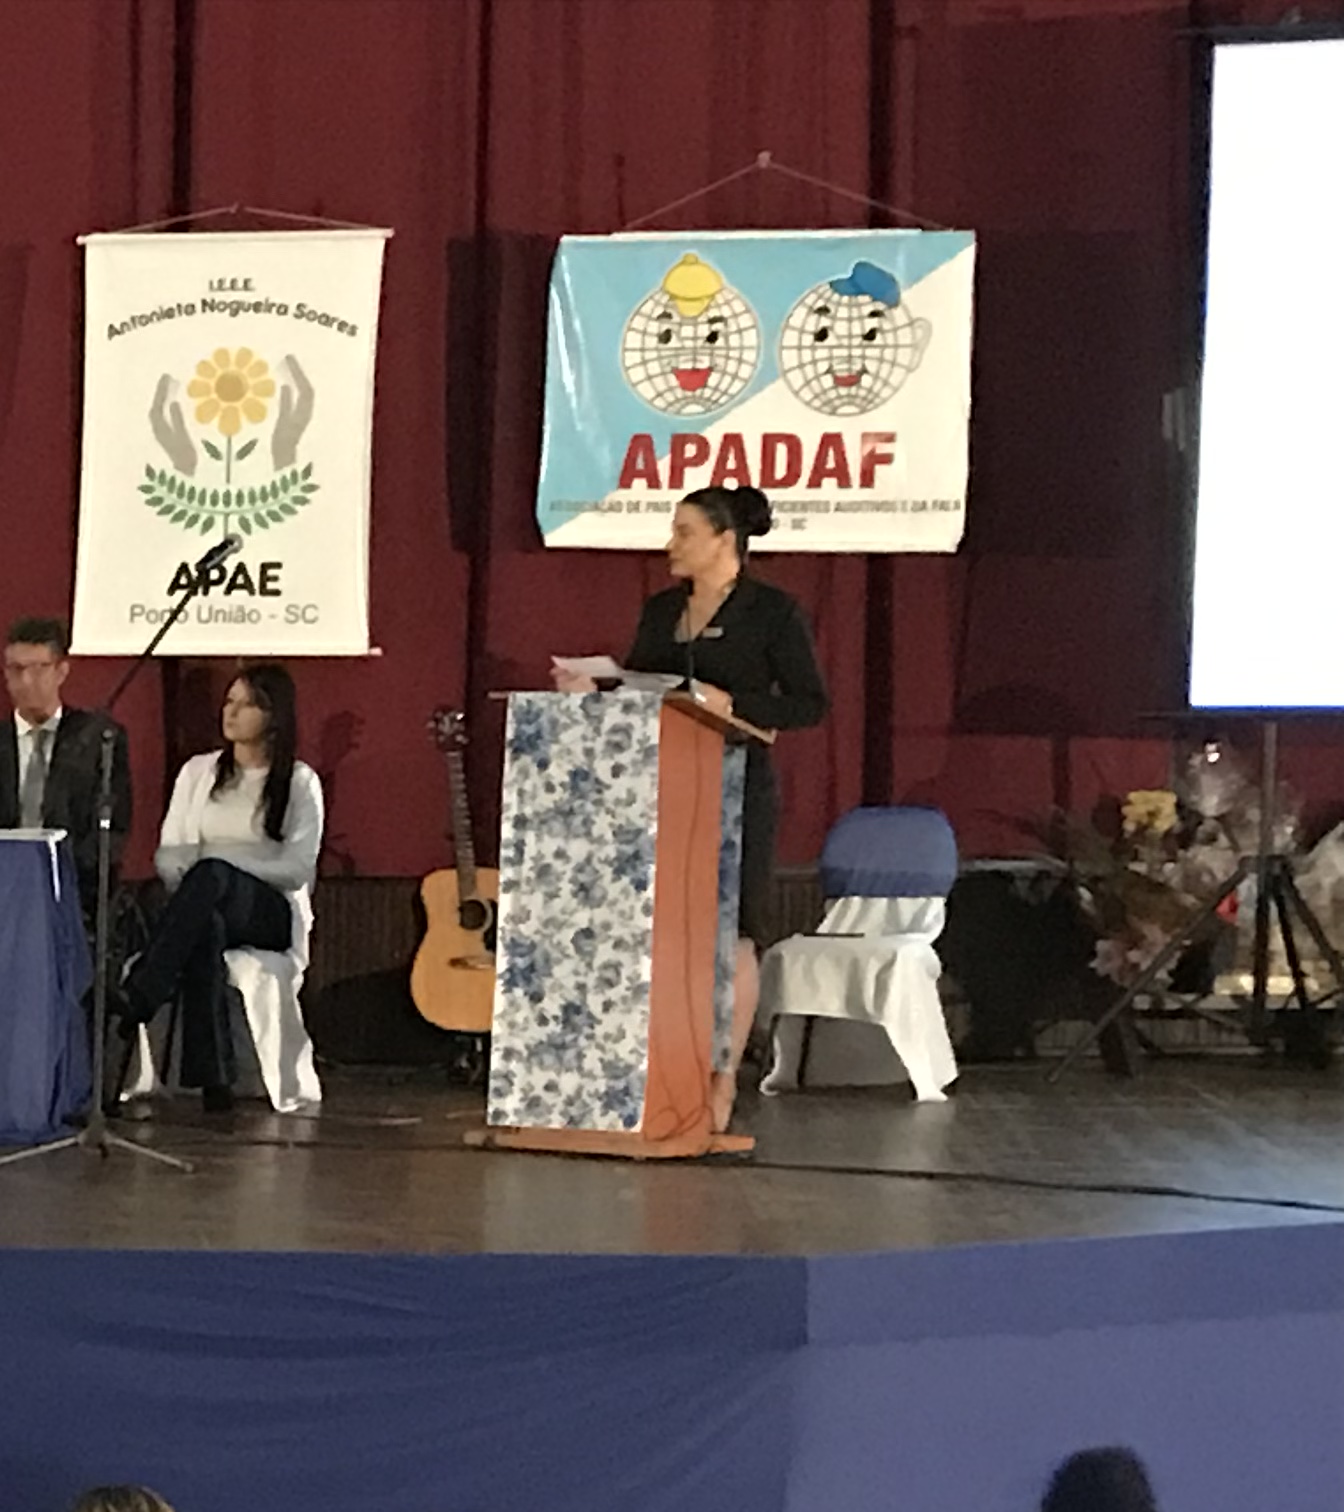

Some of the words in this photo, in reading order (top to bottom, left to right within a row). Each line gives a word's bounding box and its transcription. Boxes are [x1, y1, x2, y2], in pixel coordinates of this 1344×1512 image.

[108, 302, 196, 340] Antonieta
[201, 298, 289, 317] Nogueira
[293, 303, 358, 336] Soares
[618, 432, 897, 489] APADAF
[166, 561, 283, 597] APAE
[129, 603, 189, 624] Porto
[196, 603, 262, 624] União
[284, 603, 319, 624] SC
